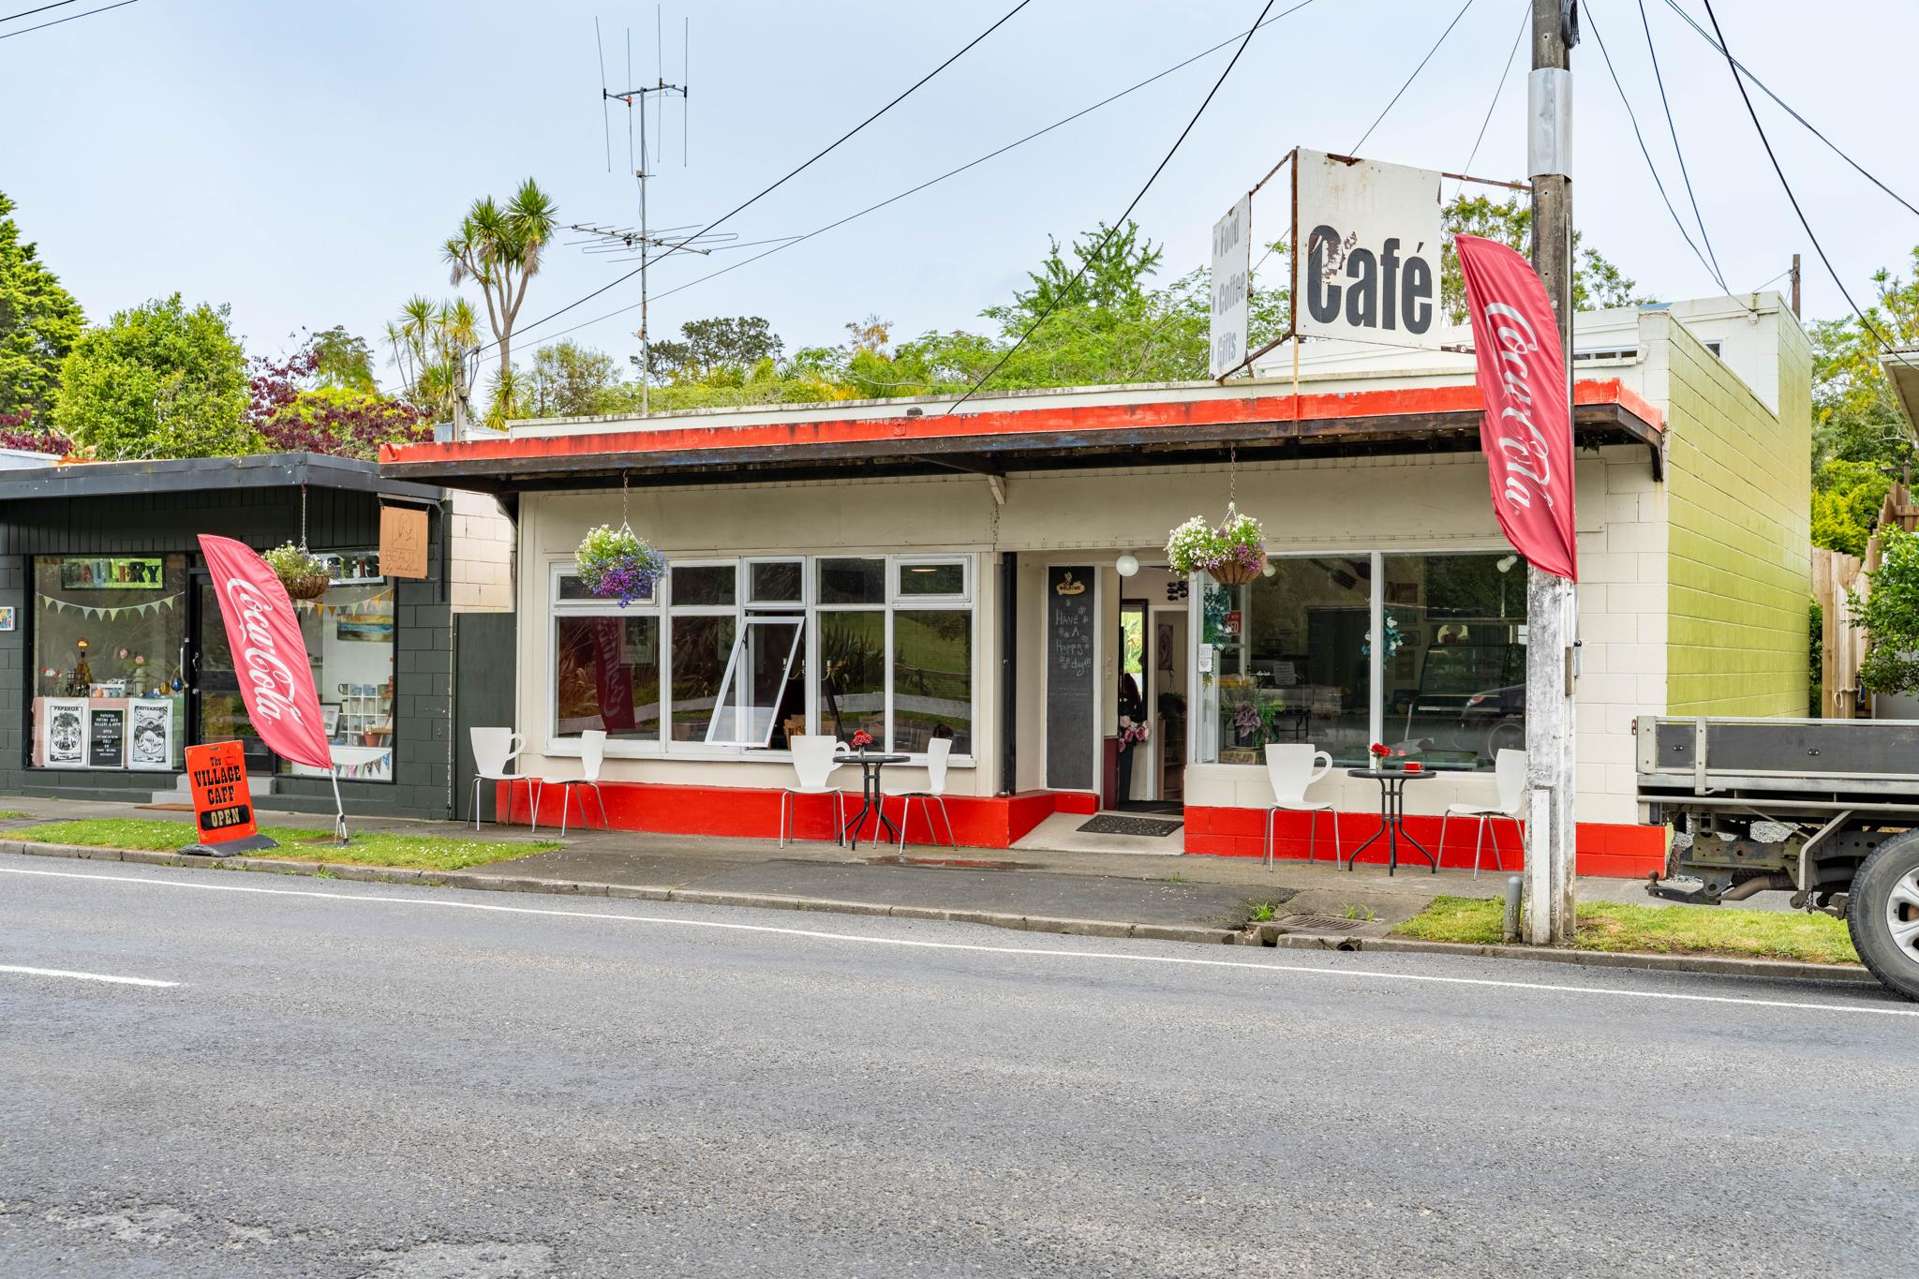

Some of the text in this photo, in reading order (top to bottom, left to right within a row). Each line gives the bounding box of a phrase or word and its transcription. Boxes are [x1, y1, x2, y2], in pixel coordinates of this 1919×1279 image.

[1220, 211, 1240, 258] Food
[1218, 271, 1246, 316] Coffee
[1307, 224, 1433, 335] Café
[1217, 331, 1237, 370] Gifts
[226, 577, 305, 726] Coca-Cola
[193, 765, 242, 788] VILLAGE
[210, 807, 241, 828] OPEN
